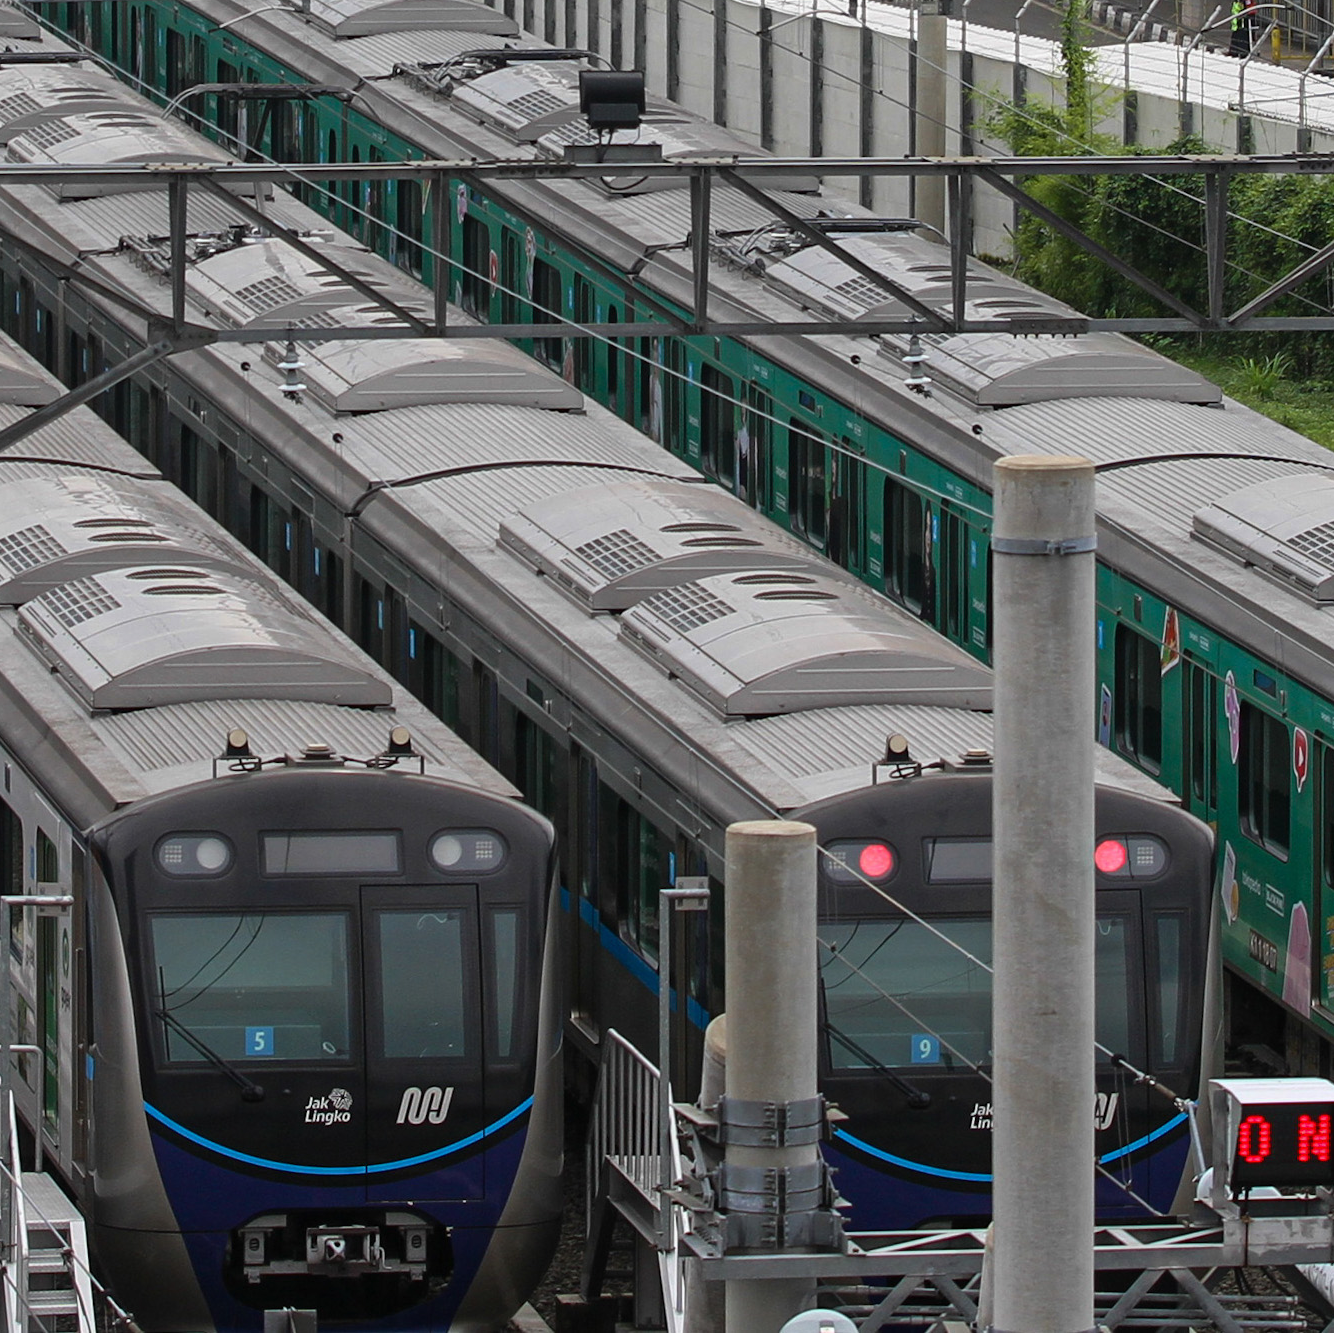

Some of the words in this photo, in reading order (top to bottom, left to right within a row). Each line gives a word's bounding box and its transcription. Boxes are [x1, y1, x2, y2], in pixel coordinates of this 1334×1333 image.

[253, 1031, 265, 1051] 5
[919, 1038, 932, 1059] 9
[305, 1097, 329, 1110] Jak
[304, 1109, 351, 1126] Lingko
